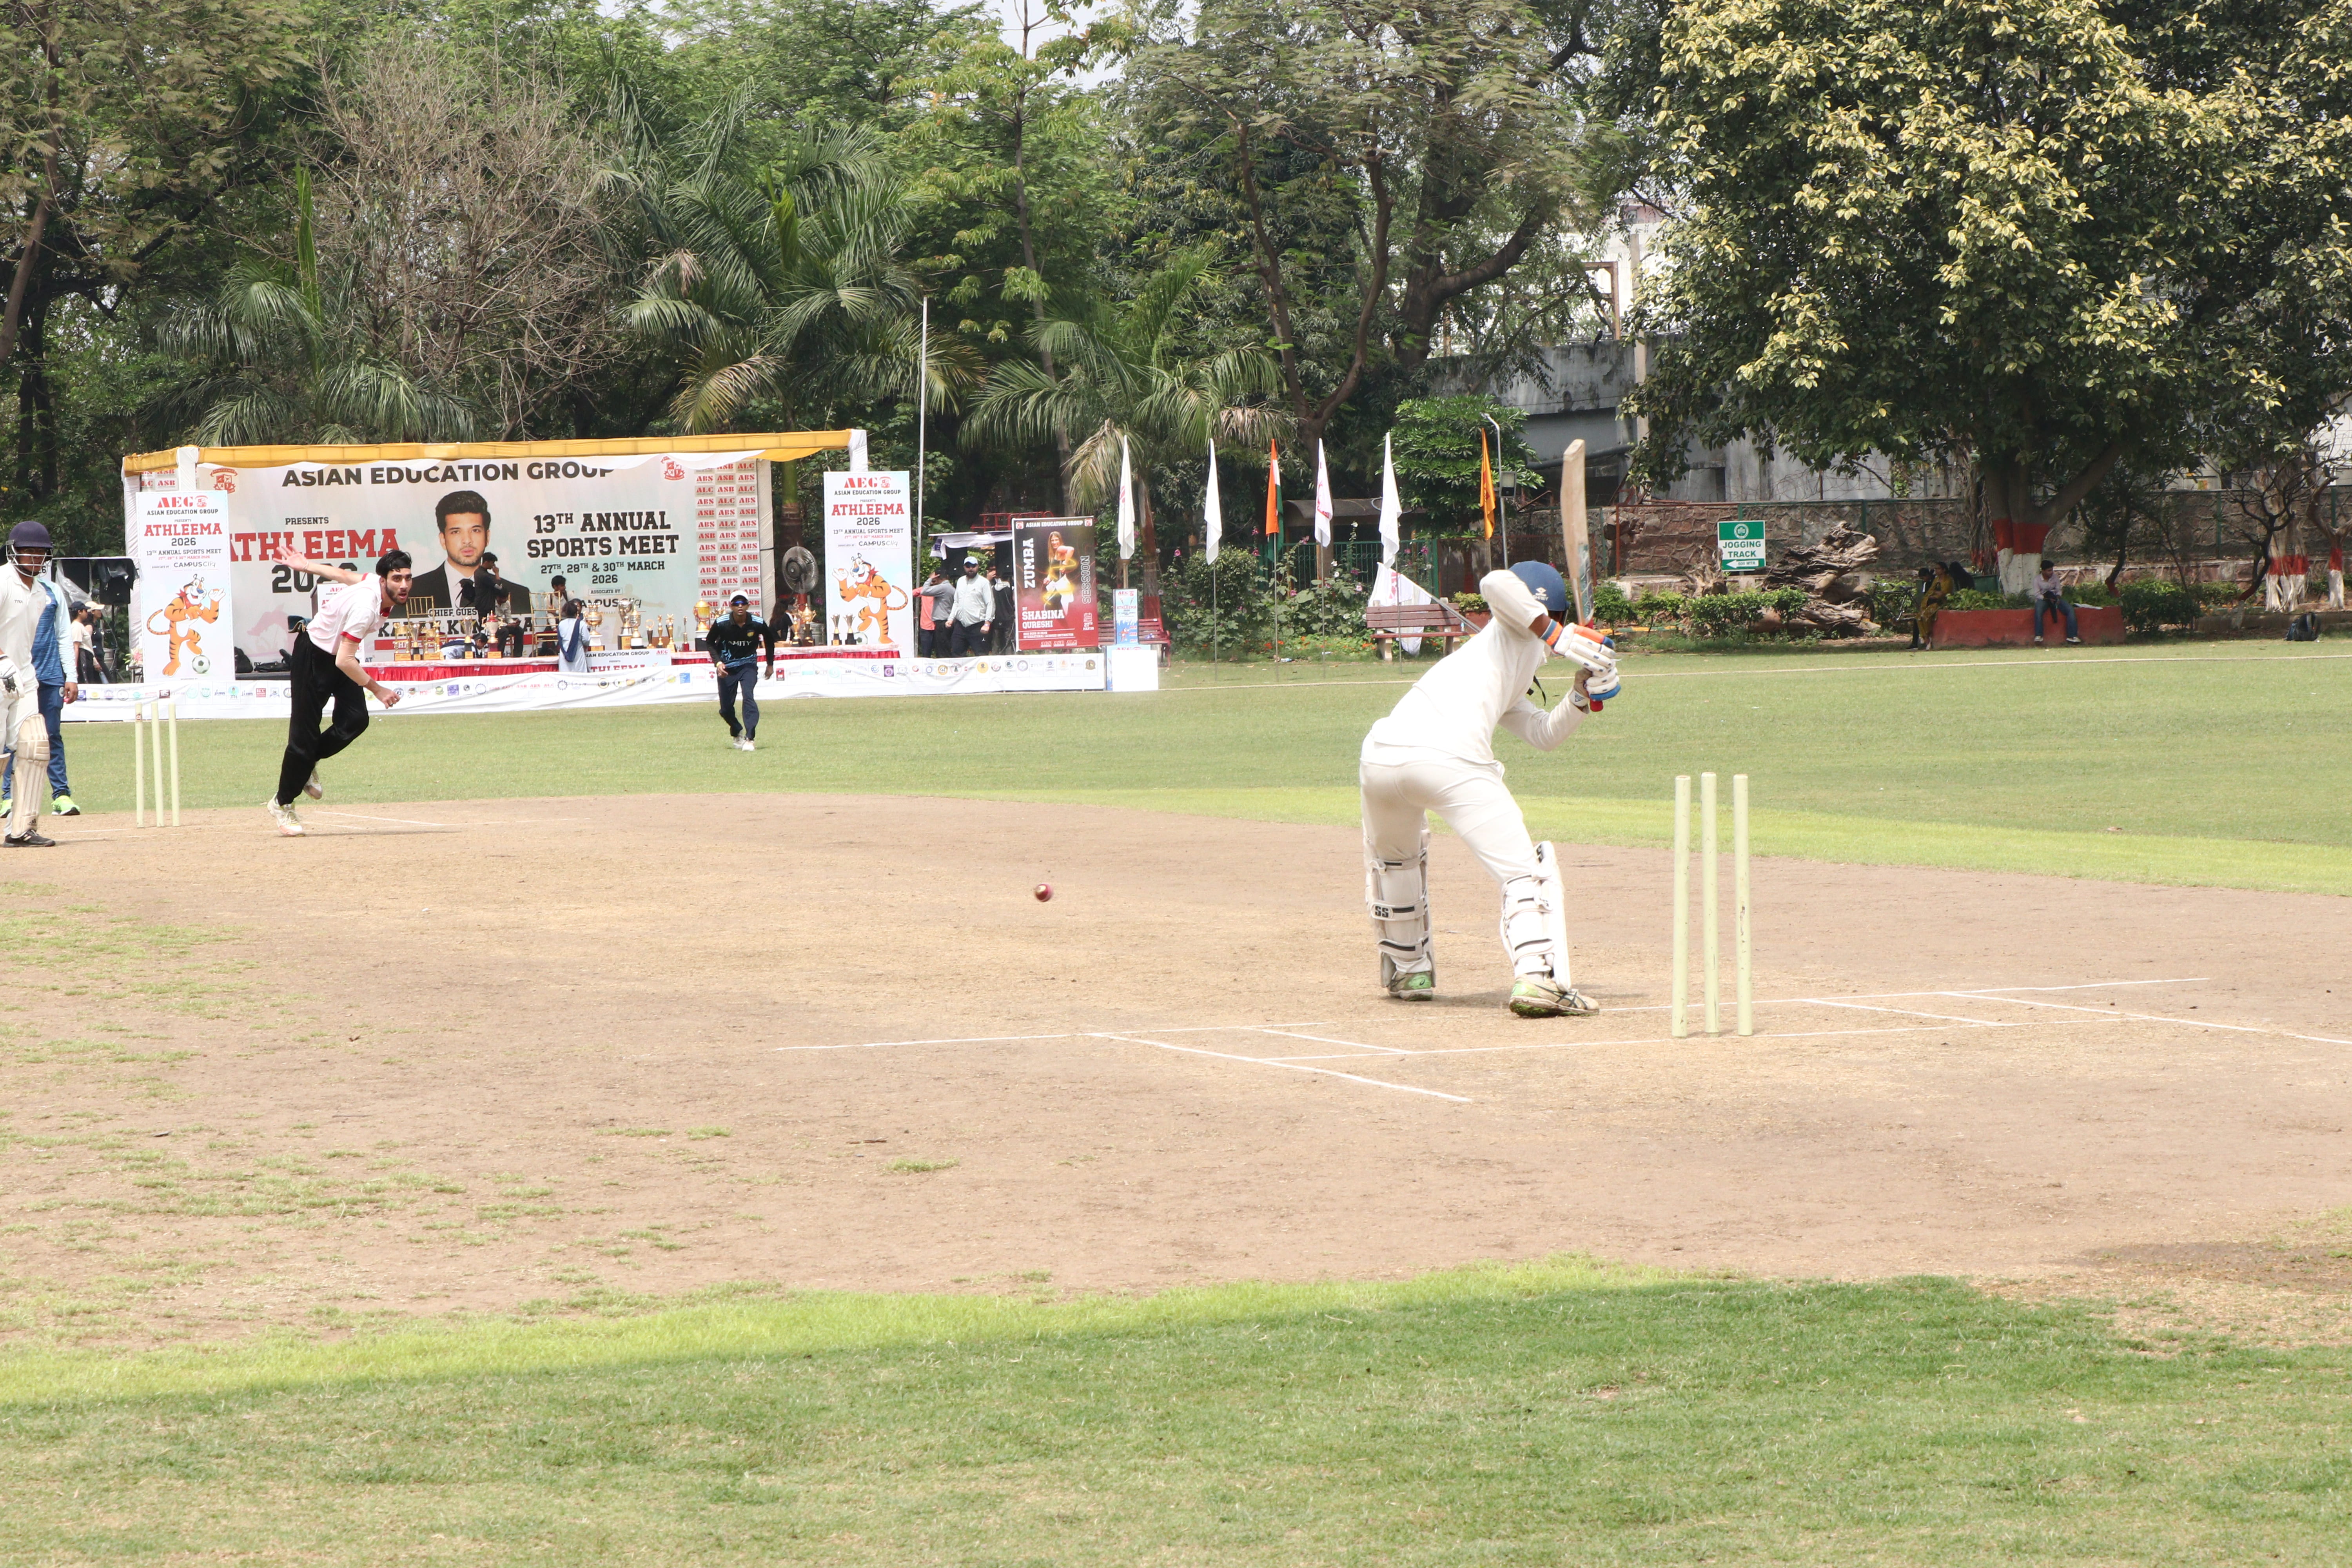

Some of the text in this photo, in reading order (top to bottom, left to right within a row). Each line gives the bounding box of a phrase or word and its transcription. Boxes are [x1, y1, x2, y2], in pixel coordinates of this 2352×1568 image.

[282, 468, 362, 487] ASIAN
[371, 463, 518, 485] EDUCATION
[844, 477, 877, 488] AEG
[158, 496, 193, 508] AEG
[831, 503, 904, 515] ATHLEEMA
[285, 517, 329, 525] PRESENTS
[534, 511, 671, 534] 13TH ANNUAL
[144, 523, 222, 536] ATHLEEMA
[171, 537, 196, 546] 2026
[527, 534, 679, 558] SPORTS MEET
[567, 563, 588, 573] 28TH
[592, 563, 600, 572] &
[603, 562, 624, 572] 30TH
[627, 561, 665, 571] MARCH
[1022, 538, 1036, 588] ZUMBA
[592, 574, 618, 584] 2026
[1080, 555, 1091, 604] SESSION
[456, 608, 477, 616] GUES
[1022, 610, 1065, 620] SHABINA
[1022, 620, 1053, 629] QURESHI
[1375, 906, 1389, 918] SS
